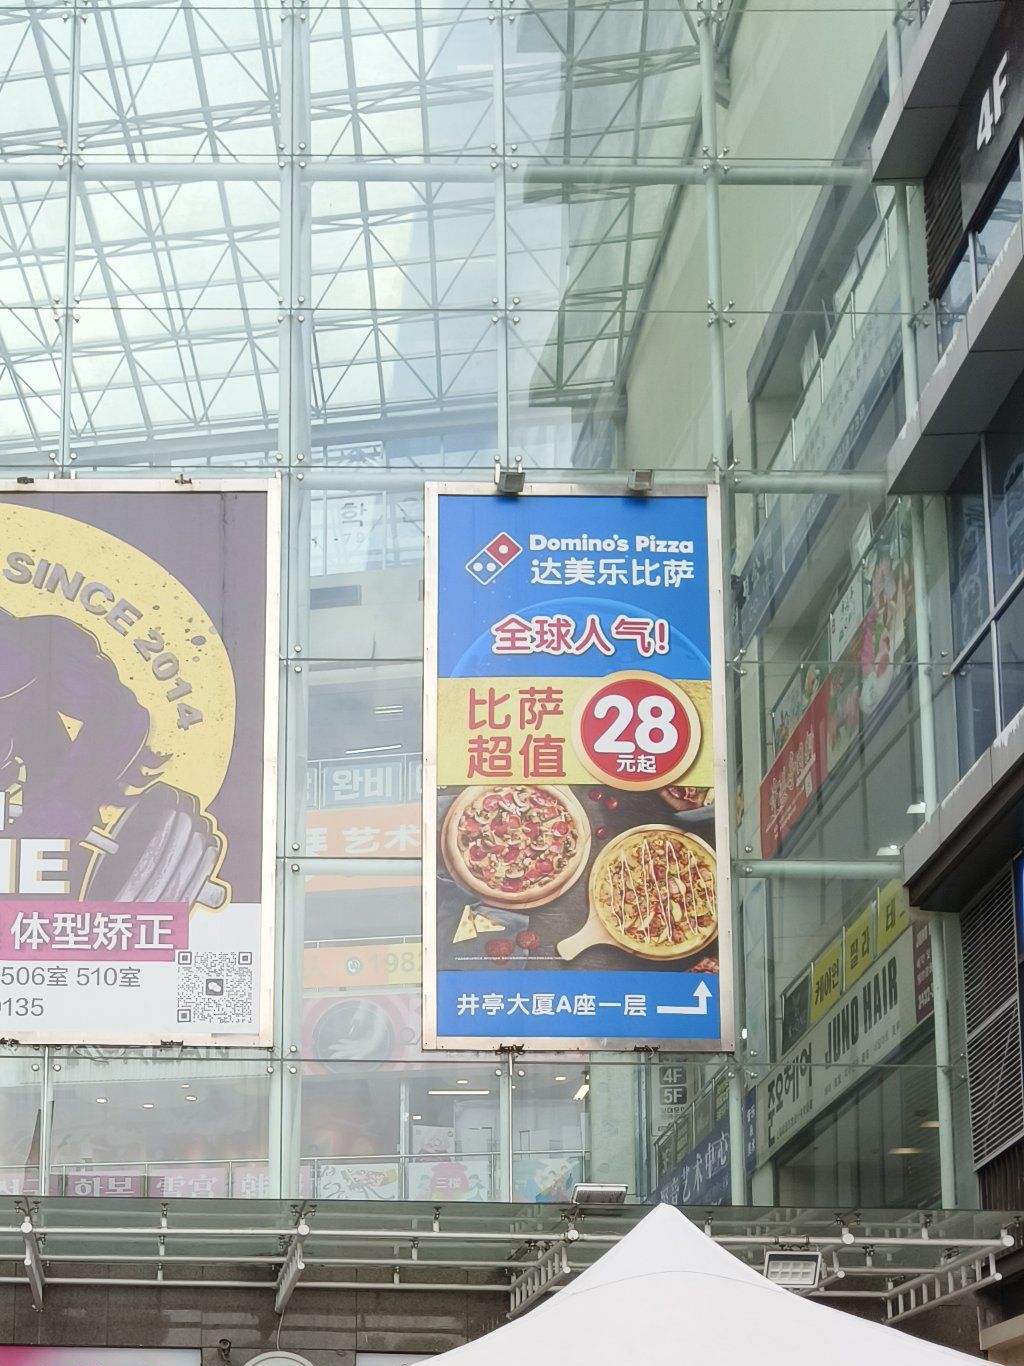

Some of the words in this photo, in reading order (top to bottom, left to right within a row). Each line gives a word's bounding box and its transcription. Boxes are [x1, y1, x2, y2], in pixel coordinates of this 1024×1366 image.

[977, 50, 1009, 151] 4F
[529, 533, 630, 552] Domino's
[635, 535, 694, 554] Pizza
[531, 557, 694, 588] 达美乐比萨
[2, 551, 142, 636] SINCE
[134, 627, 204, 731] 2014
[492, 614, 669, 656] 全球人气!
[467, 687, 564, 731] 比萨
[593, 693, 678, 754] 28
[466, 733, 566, 778] 超值
[616, 754, 656, 774] 元起
[10, 911, 175, 951] 体型矫正
[1, 965, 69, 988] 506室
[76, 966, 141, 988] 510室
[863, 956, 898, 1034] HAIR
[456, 993, 647, 1018] 井亭大厦A座一层
[663, 1068, 682, 1083] 4F
[664, 1089, 683, 1104] 5F
